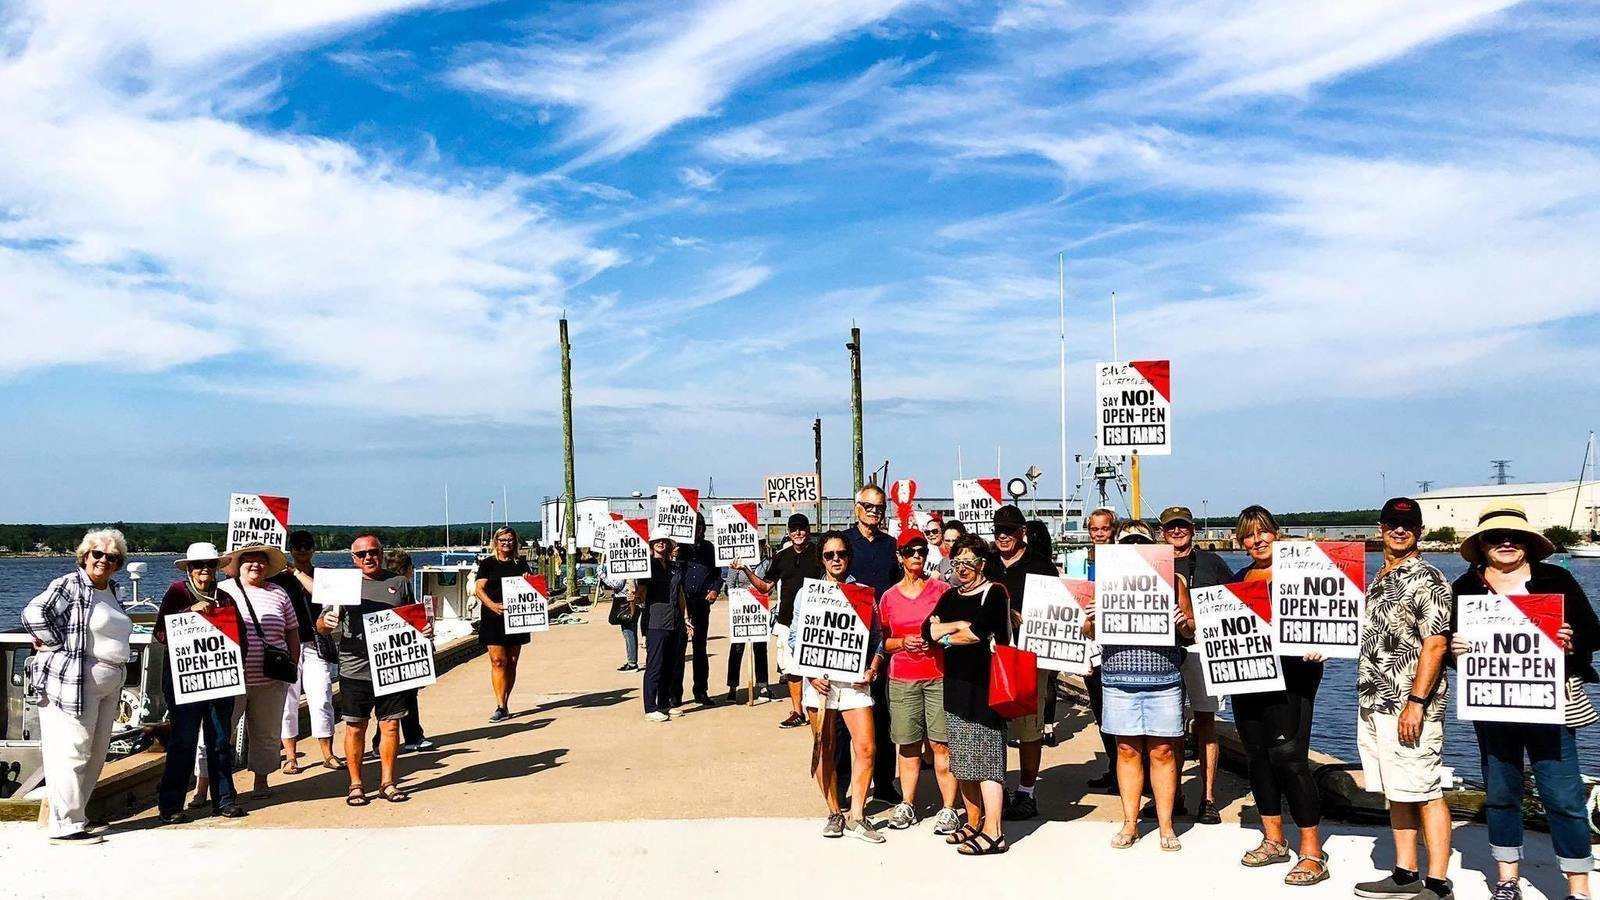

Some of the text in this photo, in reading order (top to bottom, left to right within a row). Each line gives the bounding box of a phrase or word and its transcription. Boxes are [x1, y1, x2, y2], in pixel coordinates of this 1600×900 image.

[1102, 389, 1155, 407] SAY NO!
[1103, 407, 1165, 424] OPEN-PEN
[1105, 426, 1165, 445] FISH FARMS
[767, 476, 816, 491] NOFISH
[769, 488, 817, 503] FARMS
[970, 498, 992, 509] NO!
[658, 513, 694, 525] OPEN-PEN
[670, 504, 689, 515] NO!
[959, 509, 997, 521] OPEN-PE
[233, 517, 276, 531] SAY NO!
[728, 522, 748, 534] NO!
[232, 530, 283, 545] OPEN-PEN
[620, 537, 640, 549] NO!
[717, 533, 755, 546] OPEN-PEN
[609, 548, 647, 560] OPEN-PEN
[1102, 574, 1158, 592] SAY NO!
[1280, 576, 1345, 597] SAY NO!
[518, 592, 538, 603] NO!
[1102, 593, 1169, 611] OPEN-PEN
[508, 602, 545, 615] OPEN-PEN
[742, 604, 761, 614] NO!
[1027, 604, 1080, 623] SAY NO!
[1280, 598, 1358, 618] OPEN-PEN
[732, 614, 767, 625] OPEN-PEN
[804, 611, 857, 631] SAY NO!
[1104, 613, 1169, 634] FISH FARMS
[1202, 615, 1258, 639] SAY NO!
[373, 630, 418, 653] SAY NO!
[802, 627, 864, 650] OPEN-PEN
[1282, 621, 1357, 645] FISH FARMS
[175, 635, 226, 657] SAY NO!
[1205, 635, 1272, 658] OPEN-PEN
[1493, 633, 1540, 654] NO!
[177, 650, 238, 673] OPEN-PEN
[375, 643, 428, 667] OPEN-PEN
[801, 646, 860, 673] FISH FARMS
[379, 660, 430, 686] FISH FARMS
[1210, 657, 1276, 683] FISH FARMS
[1466, 657, 1556, 678] OPEN-PEN
[181, 668, 239, 693] FISH FARMS
[1469, 682, 1555, 708] FISH FARMS
